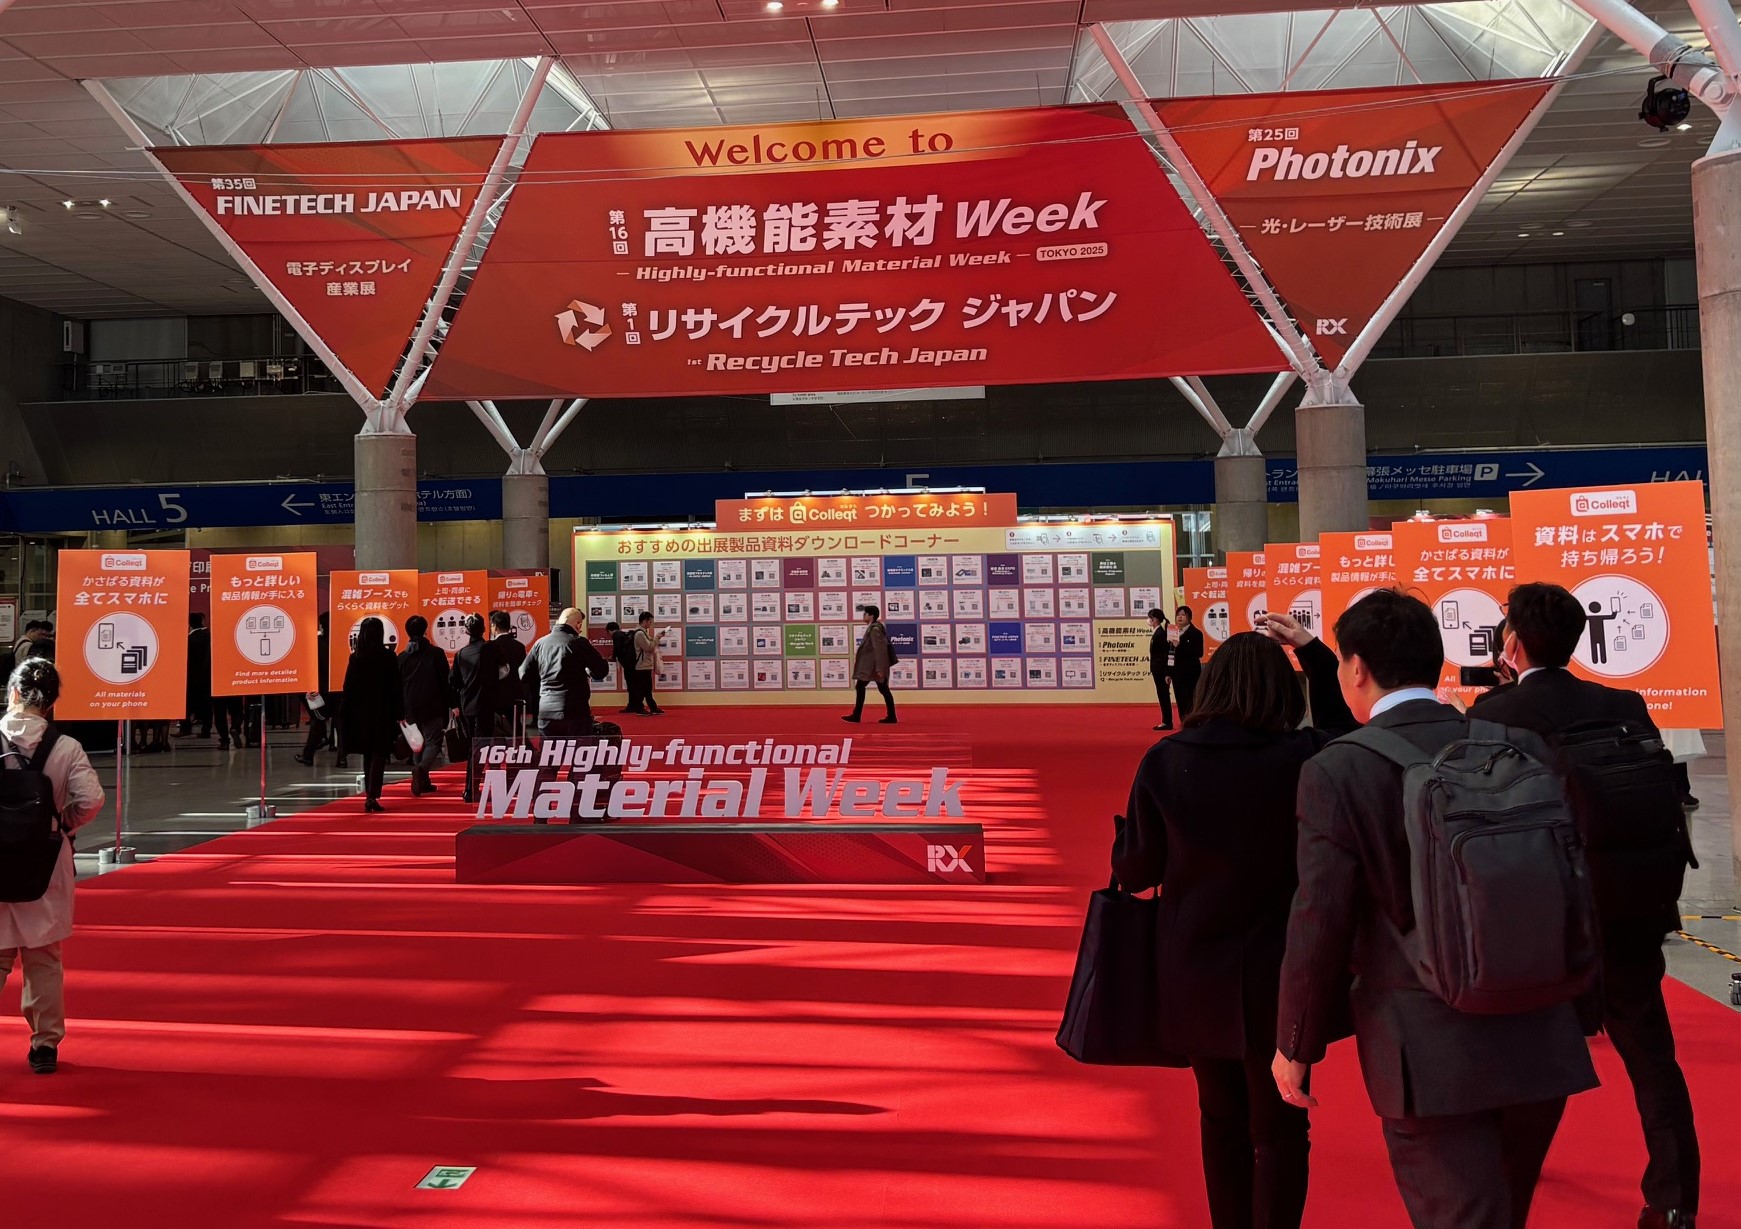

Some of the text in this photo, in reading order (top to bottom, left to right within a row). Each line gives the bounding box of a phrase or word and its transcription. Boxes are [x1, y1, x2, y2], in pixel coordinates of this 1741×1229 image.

[1248, 127, 1299, 142] 第25回
[685, 128, 953, 166] Welcome to
[1246, 140, 1442, 181] Photonix
[211, 177, 256, 190] 第35回
[216, 188, 462, 215] FINETECH JAPAN
[643, 191, 1108, 257] 高機能素材 Week
[1260, 212, 1424, 235] 光・レーザー技術展
[608, 210, 629, 255] 第16回
[1040, 245, 1105, 258] TOKYO 2025
[286, 258, 412, 276] 電子ディスプレイ
[636, 250, 1012, 282] Highly-functional Material Week
[326, 281, 376, 296] 産業展
[649, 288, 1118, 341] リサイクルテック ジャパン
[621, 302, 642, 345] 第1回
[1316, 318, 1348, 335] RX
[706, 351, 824, 373] Recycle
[829, 347, 898, 367] Tech
[902, 348, 987, 367] Japan
[1367, 464, 1473, 477] 幕張メッセ駐車場
[1367, 476, 1408, 484] Makuhari
[1439, 474, 1473, 482] Parking
[318, 493, 355, 503] 東エン
[1591, 500, 1631, 511] Colleqt
[91, 493, 188, 525] HALL 5
[738, 501, 990, 522] まずは Colleqt つかってみよう！
[1453, 530, 1483, 539] Colleqt
[1534, 521, 1684, 547] 資料はスマホで
[617, 534, 960, 554] おすすめの出展製品資料ダウンロードコーナー
[1339, 555, 1396, 567] もっと詳し
[1420, 547, 1510, 562] かさばる資料が
[1560, 546, 1666, 568] 持ち帰ろう！
[115, 559, 142, 567] Colleqt
[1277, 562, 1320, 574] 混雑ブー
[230, 575, 301, 587] もっと詳しい
[1273, 576, 1321, 586] らくらく資料
[1331, 570, 1396, 582] 製品情報が手に
[1413, 565, 1515, 582] 全てスマホに
[82, 576, 164, 587] かさばる資料が
[74, 591, 168, 606] 全てスマホに
[221, 590, 305, 601] 製品情報が手に入る
[341, 588, 408, 599] 混雑ブースでも
[422, 596, 481, 606] すぐ転送できる
[337, 602, 409, 610] らくらく資料をゲット
[122, 700, 148, 708] phone
[1646, 701, 1674, 710] one!
[478, 738, 852, 772] 16th Highly-functional
[476, 767, 965, 819] Material Week
[927, 845, 974, 873] RX
